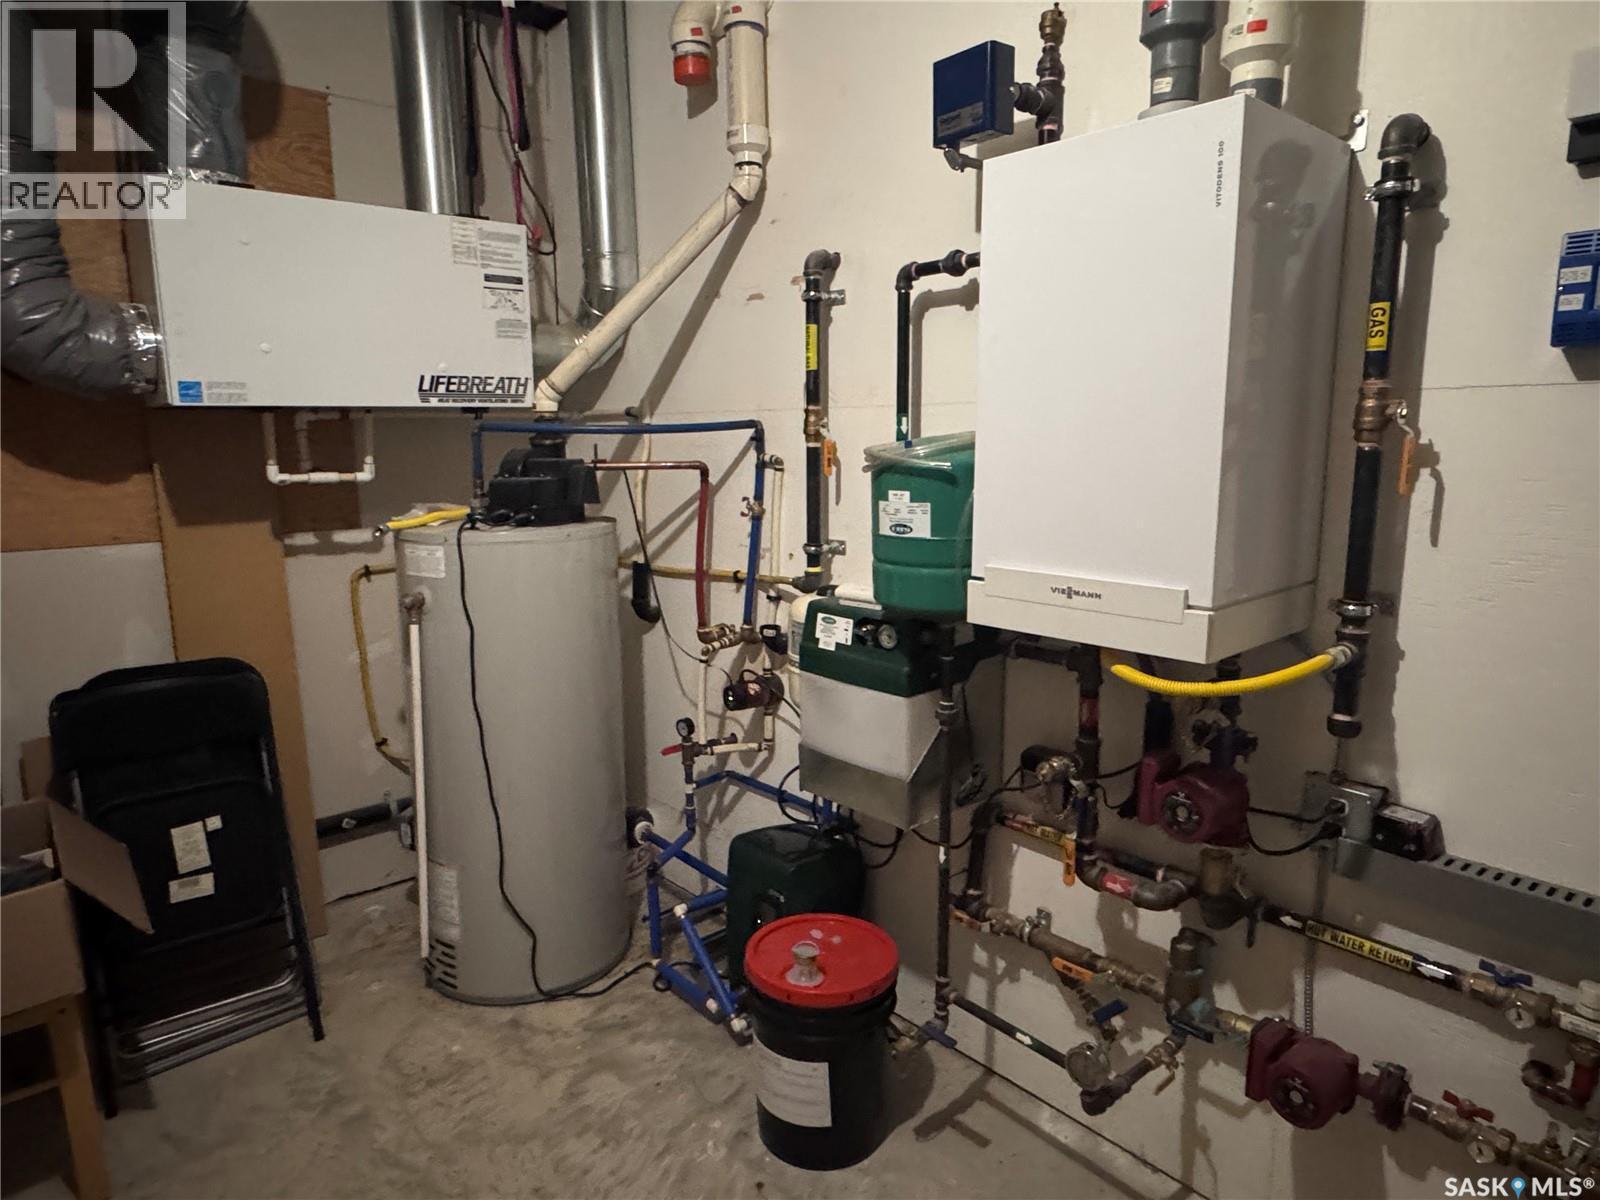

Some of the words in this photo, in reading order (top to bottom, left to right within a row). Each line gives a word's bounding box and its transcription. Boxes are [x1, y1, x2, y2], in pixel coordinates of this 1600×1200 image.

[1369, 306, 1387, 339] GAS
[418, 375, 529, 394] LIFEBREATH
[1329, 931, 1365, 953] WATER
[1367, 945, 1410, 968] RETURN
